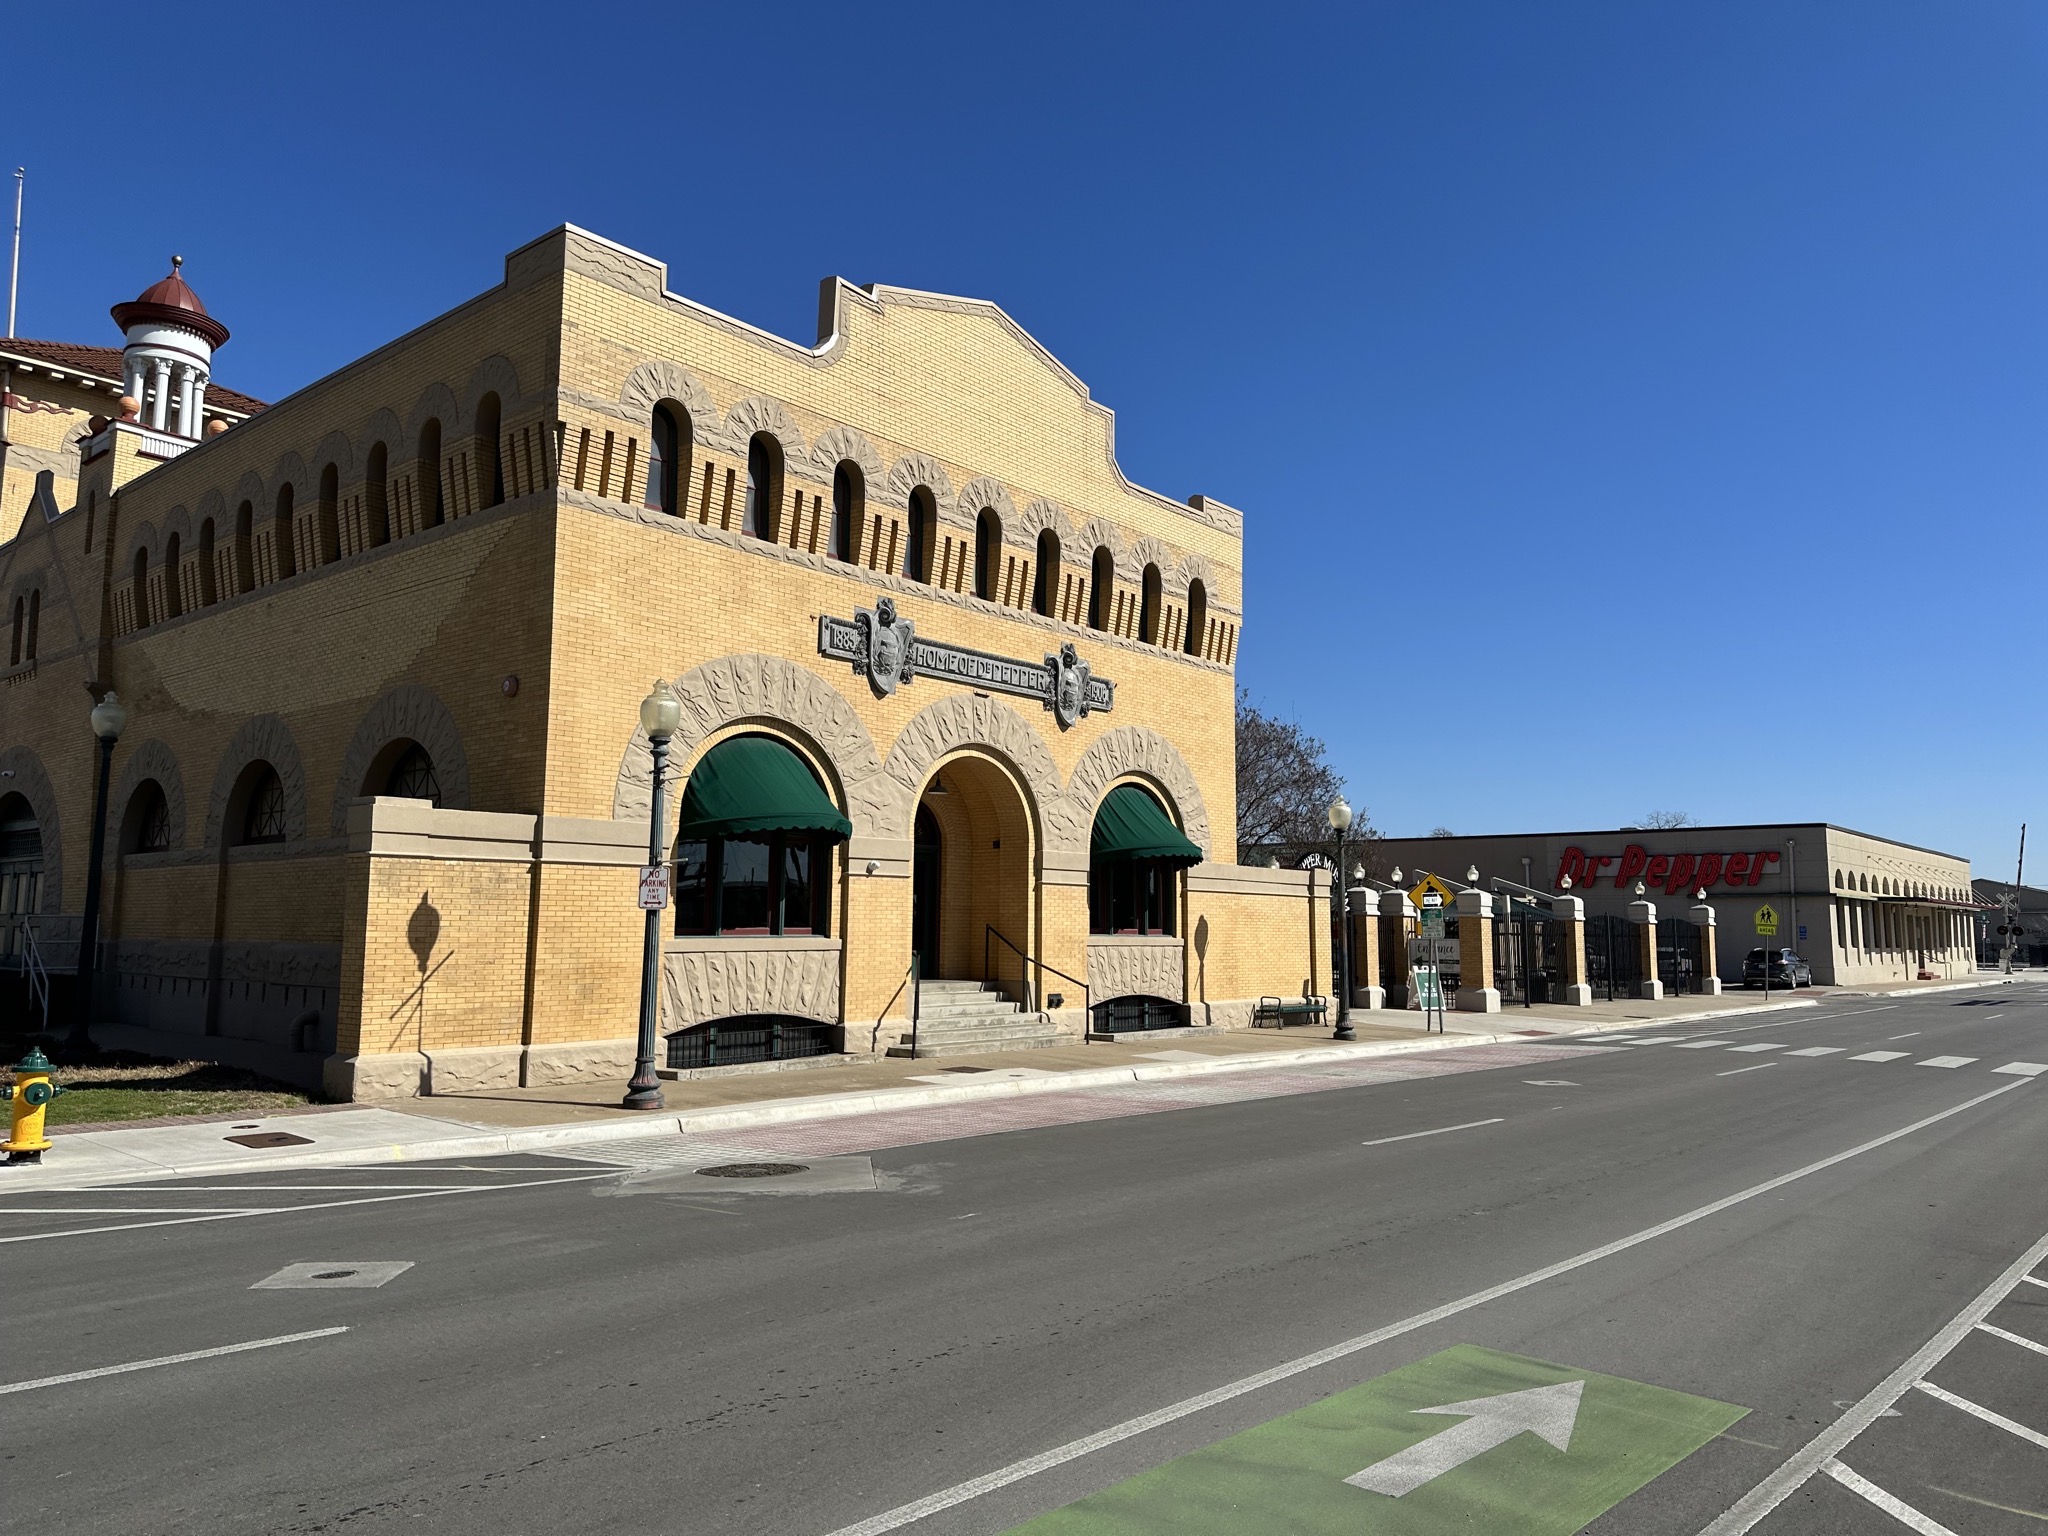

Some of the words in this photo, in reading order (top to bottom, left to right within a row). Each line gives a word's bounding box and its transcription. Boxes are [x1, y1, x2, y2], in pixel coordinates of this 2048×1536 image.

[832, 626, 856, 650] 1885
[915, 645, 957, 672] HOME
[957, 656, 976, 676] OF
[991, 663, 1046, 691] PEPPER
[649, 870, 660, 878] NO
[1555, 846, 1612, 889] Dr
[1615, 844, 1780, 896] Pepper
[641, 879, 667, 888] PARKING
